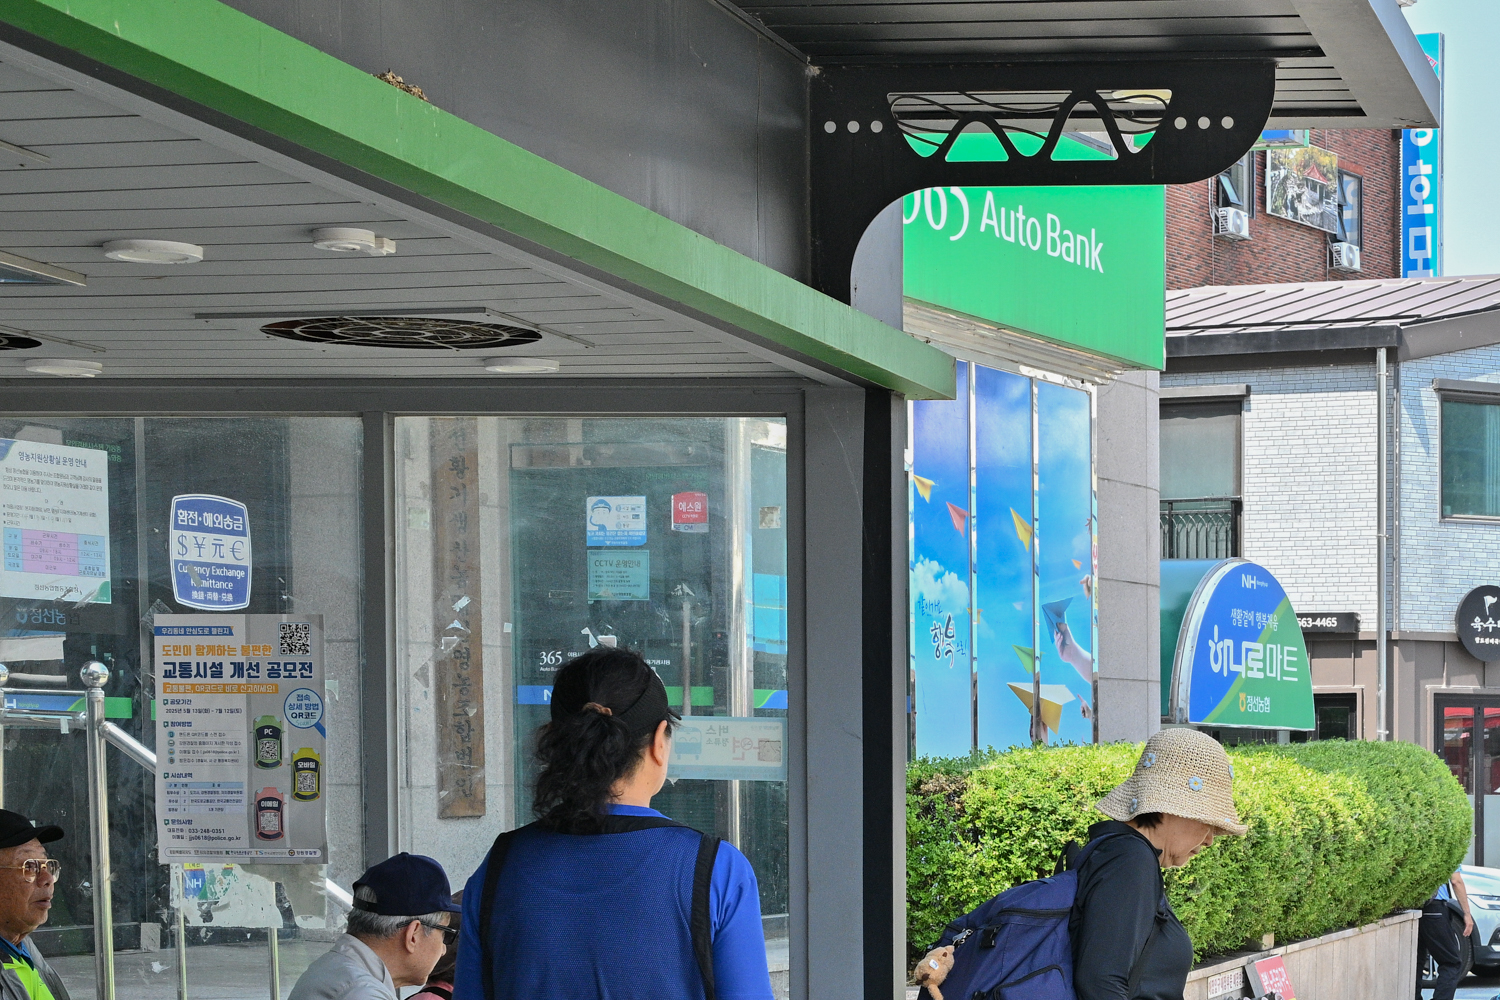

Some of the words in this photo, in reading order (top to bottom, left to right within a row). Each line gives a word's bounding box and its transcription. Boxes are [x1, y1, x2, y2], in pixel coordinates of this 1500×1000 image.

[980, 191, 1041, 251] Auto
[1047, 213, 1104, 273] Bank
[18, 451, 61, 466] 영농지원상황실
[62, 457, 74, 467] 운영
[75, 458, 87, 468] 안내
[678, 501, 702, 513] 에스원
[177, 508, 244, 531] 환전·해외송금
[177, 563, 210, 577] Cuency
[211, 566, 245, 580] Exchange
[594, 559, 614, 567] CCTV
[615, 559, 641, 569] 운영안내
[1241, 573, 1257, 589] NH
[1255, 611, 1279, 632] 행복채움
[161, 627, 184, 635] 우리동네
[186, 627, 210, 635] 안심도로
[930, 613, 955, 668] 행복
[162, 644, 192, 657] 도민이
[195, 644, 237, 657] 함께하는
[240, 644, 272, 657] 불편한
[539, 650, 563, 666] 365
[162, 661, 224, 679] 교통시설
[230, 661, 260, 679] 개선
[266, 661, 313, 679] 공모전
[195, 684, 223, 693] QR코드로
[226, 684, 238, 693] 바로
[240, 684, 276, 693] 신고하세요!
[288, 703, 303, 711] 상세
[305, 703, 320, 711] 방법
[1246, 695, 1271, 713] 정선농협
[290, 711, 317, 720] QR코드
[297, 761, 316, 769] 모바일
[186, 878, 202, 889] NH
